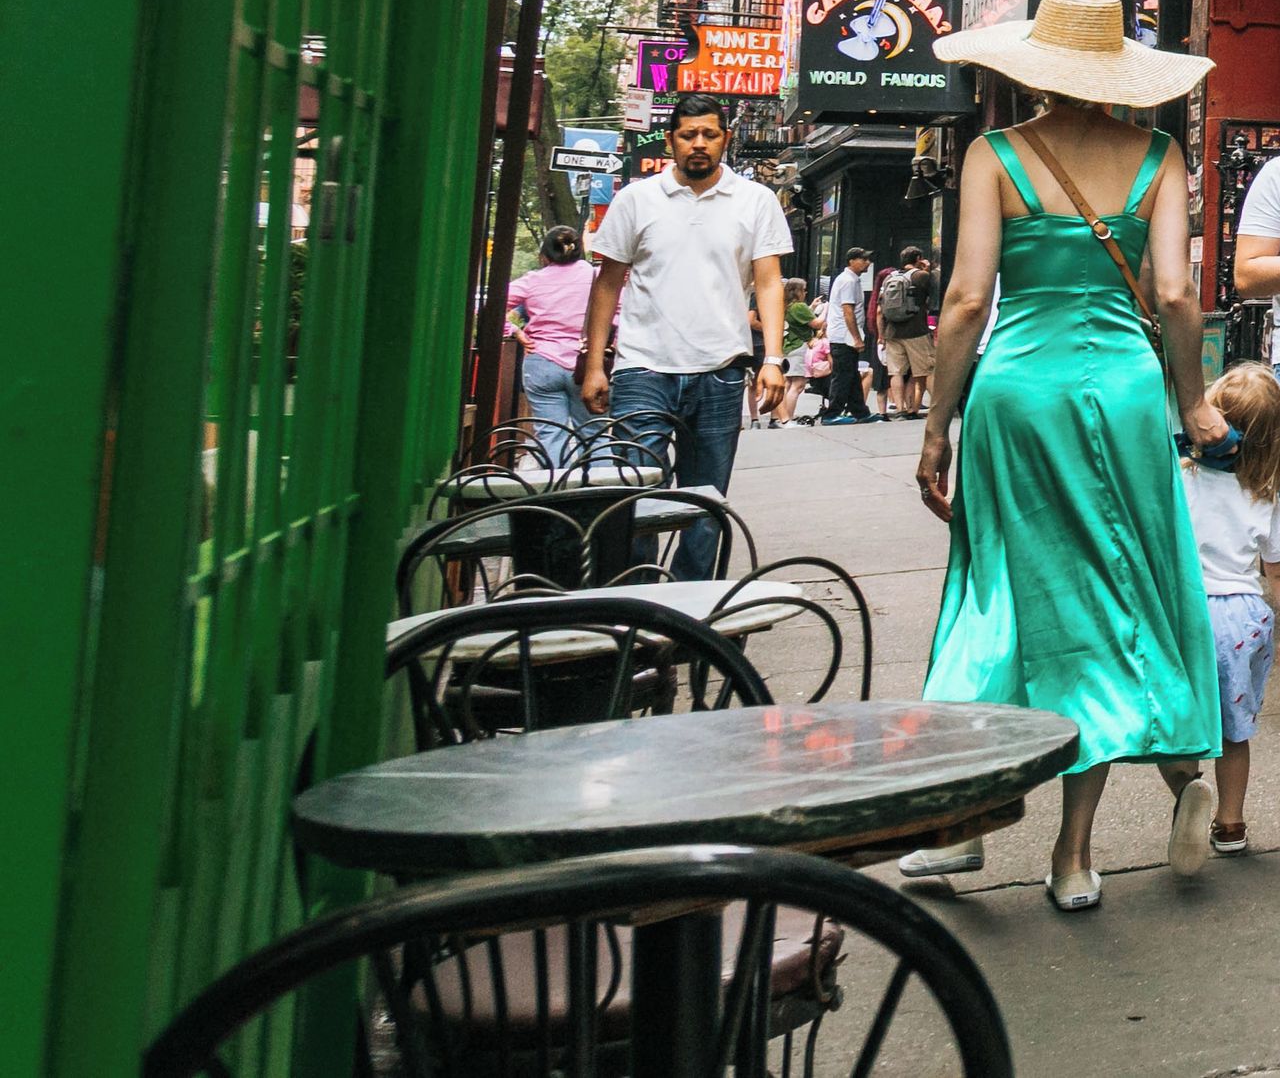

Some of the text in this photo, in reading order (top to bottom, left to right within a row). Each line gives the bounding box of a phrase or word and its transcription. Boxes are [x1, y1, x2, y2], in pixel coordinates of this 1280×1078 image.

[705, 30, 784, 53] MINETT
[683, 69, 780, 95] RESTAUR
[810, 70, 946, 88] WORLD FAMOUS
[563, 155, 618, 168] ONE WAY
